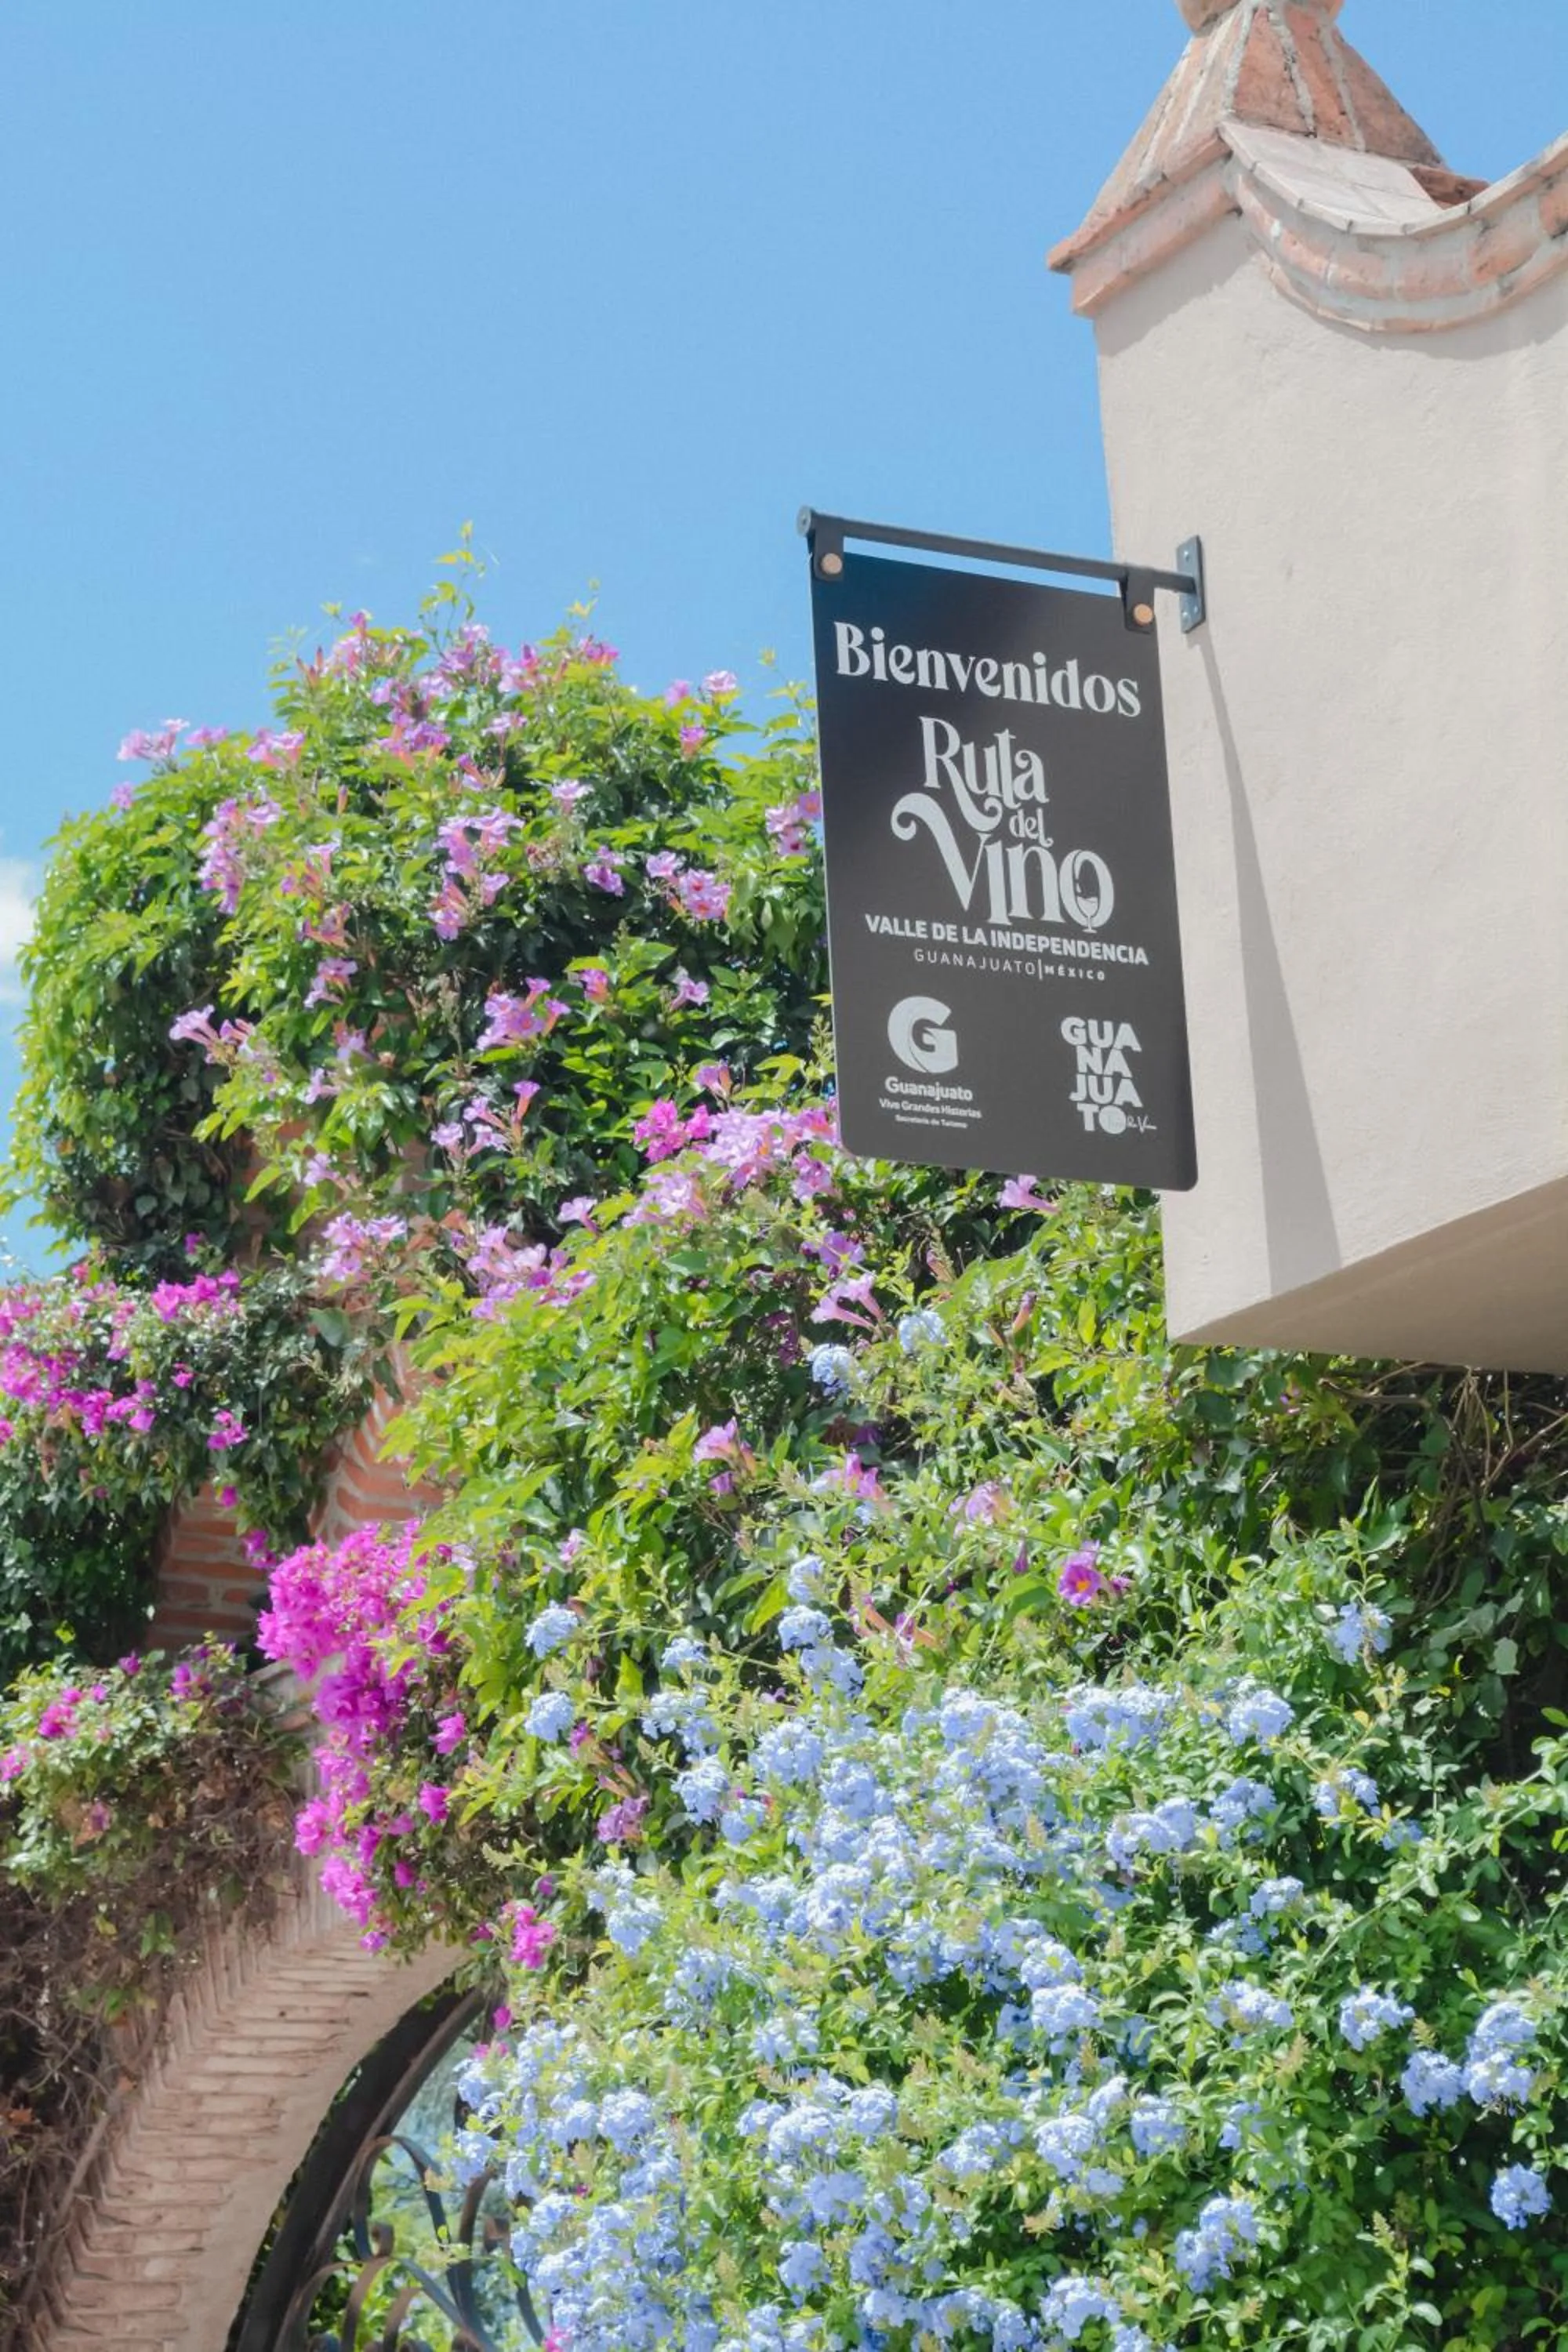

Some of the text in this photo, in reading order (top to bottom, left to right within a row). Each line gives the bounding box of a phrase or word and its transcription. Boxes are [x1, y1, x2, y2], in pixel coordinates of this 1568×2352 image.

[833, 621, 1141, 717] Bienvenidos
[919, 716, 1050, 832] Ruta
[1009, 808, 1054, 847] del
[865, 913, 1149, 966] VALLE DE LA INDEPENDENCIA
[913, 948, 1105, 981] GUANAJUATO MÉXICO
[1061, 1016, 1142, 1052] GUA
[1076, 1046, 1133, 1078] NA
[884, 1076, 973, 1102] Guanajuato
[1069, 1074, 1143, 1108] JUA
[1076, 1102, 1127, 1134] TO
